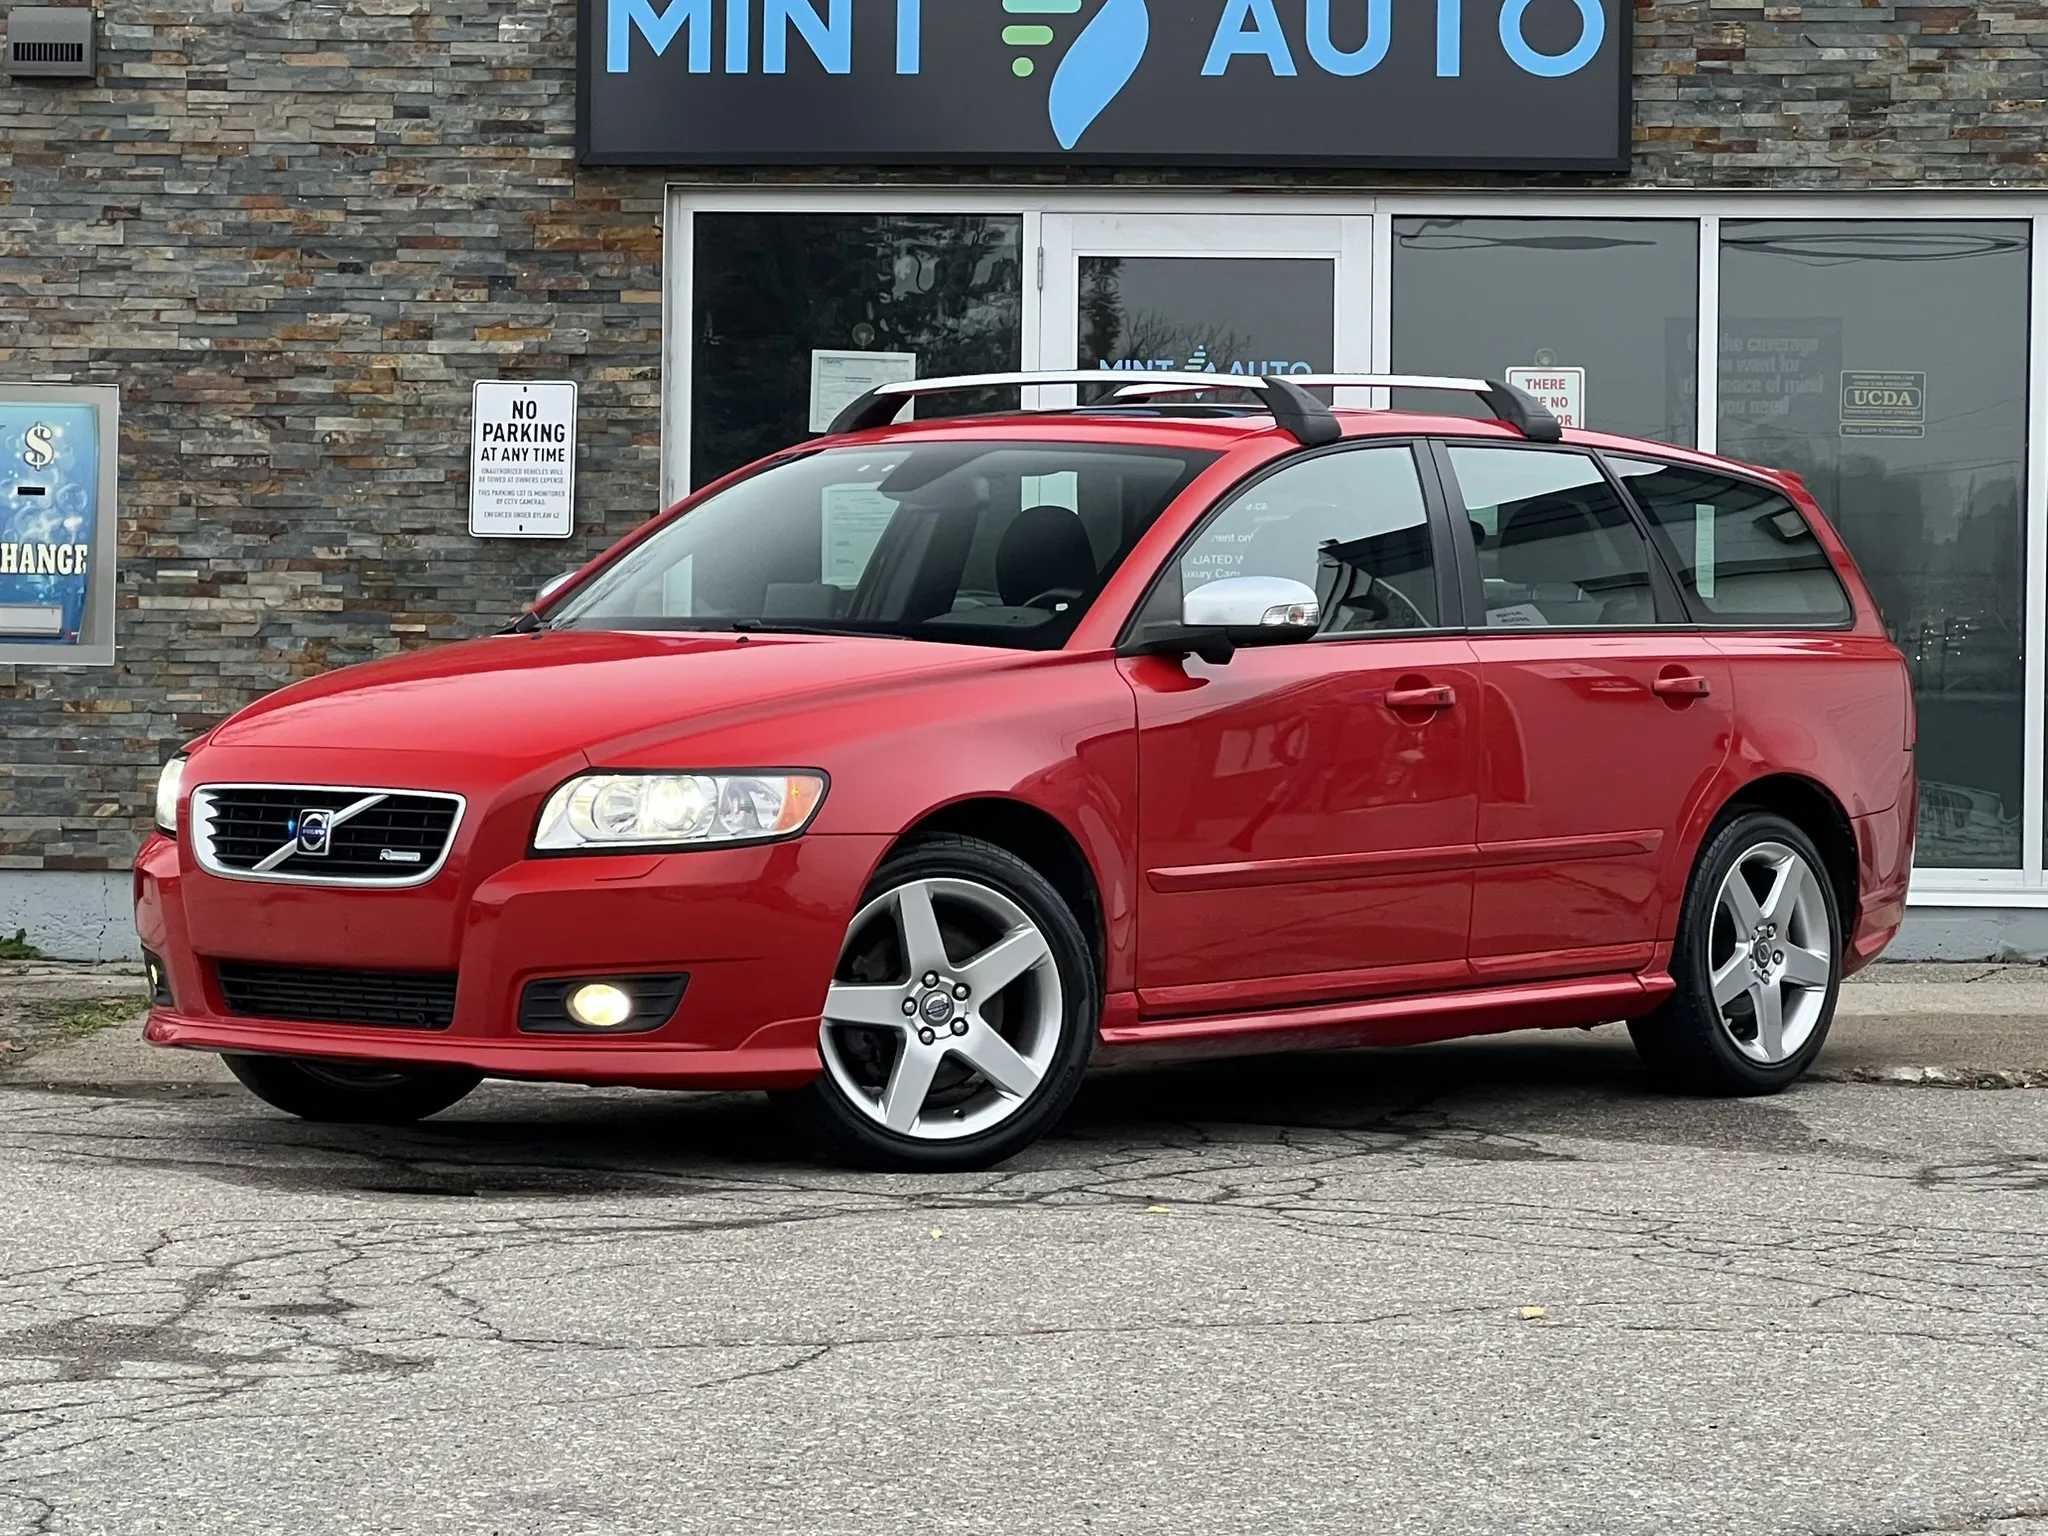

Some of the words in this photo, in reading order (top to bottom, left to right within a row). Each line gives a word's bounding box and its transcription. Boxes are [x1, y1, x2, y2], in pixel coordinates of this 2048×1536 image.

[1525, 379, 1566, 390] THERE
[1551, 396, 1568, 408] NO
[1853, 390, 1913, 406] UCDA
[512, 400, 537, 420] NO
[482, 422, 566, 443] PARKING
[480, 447, 497, 461] AT
[501, 447, 529, 462] ANY
[533, 447, 565, 462] TIME
[0, 543, 88, 576] HANGE
[1191, 554, 1233, 565] LIATED
[1184, 570, 1213, 580] uxury
